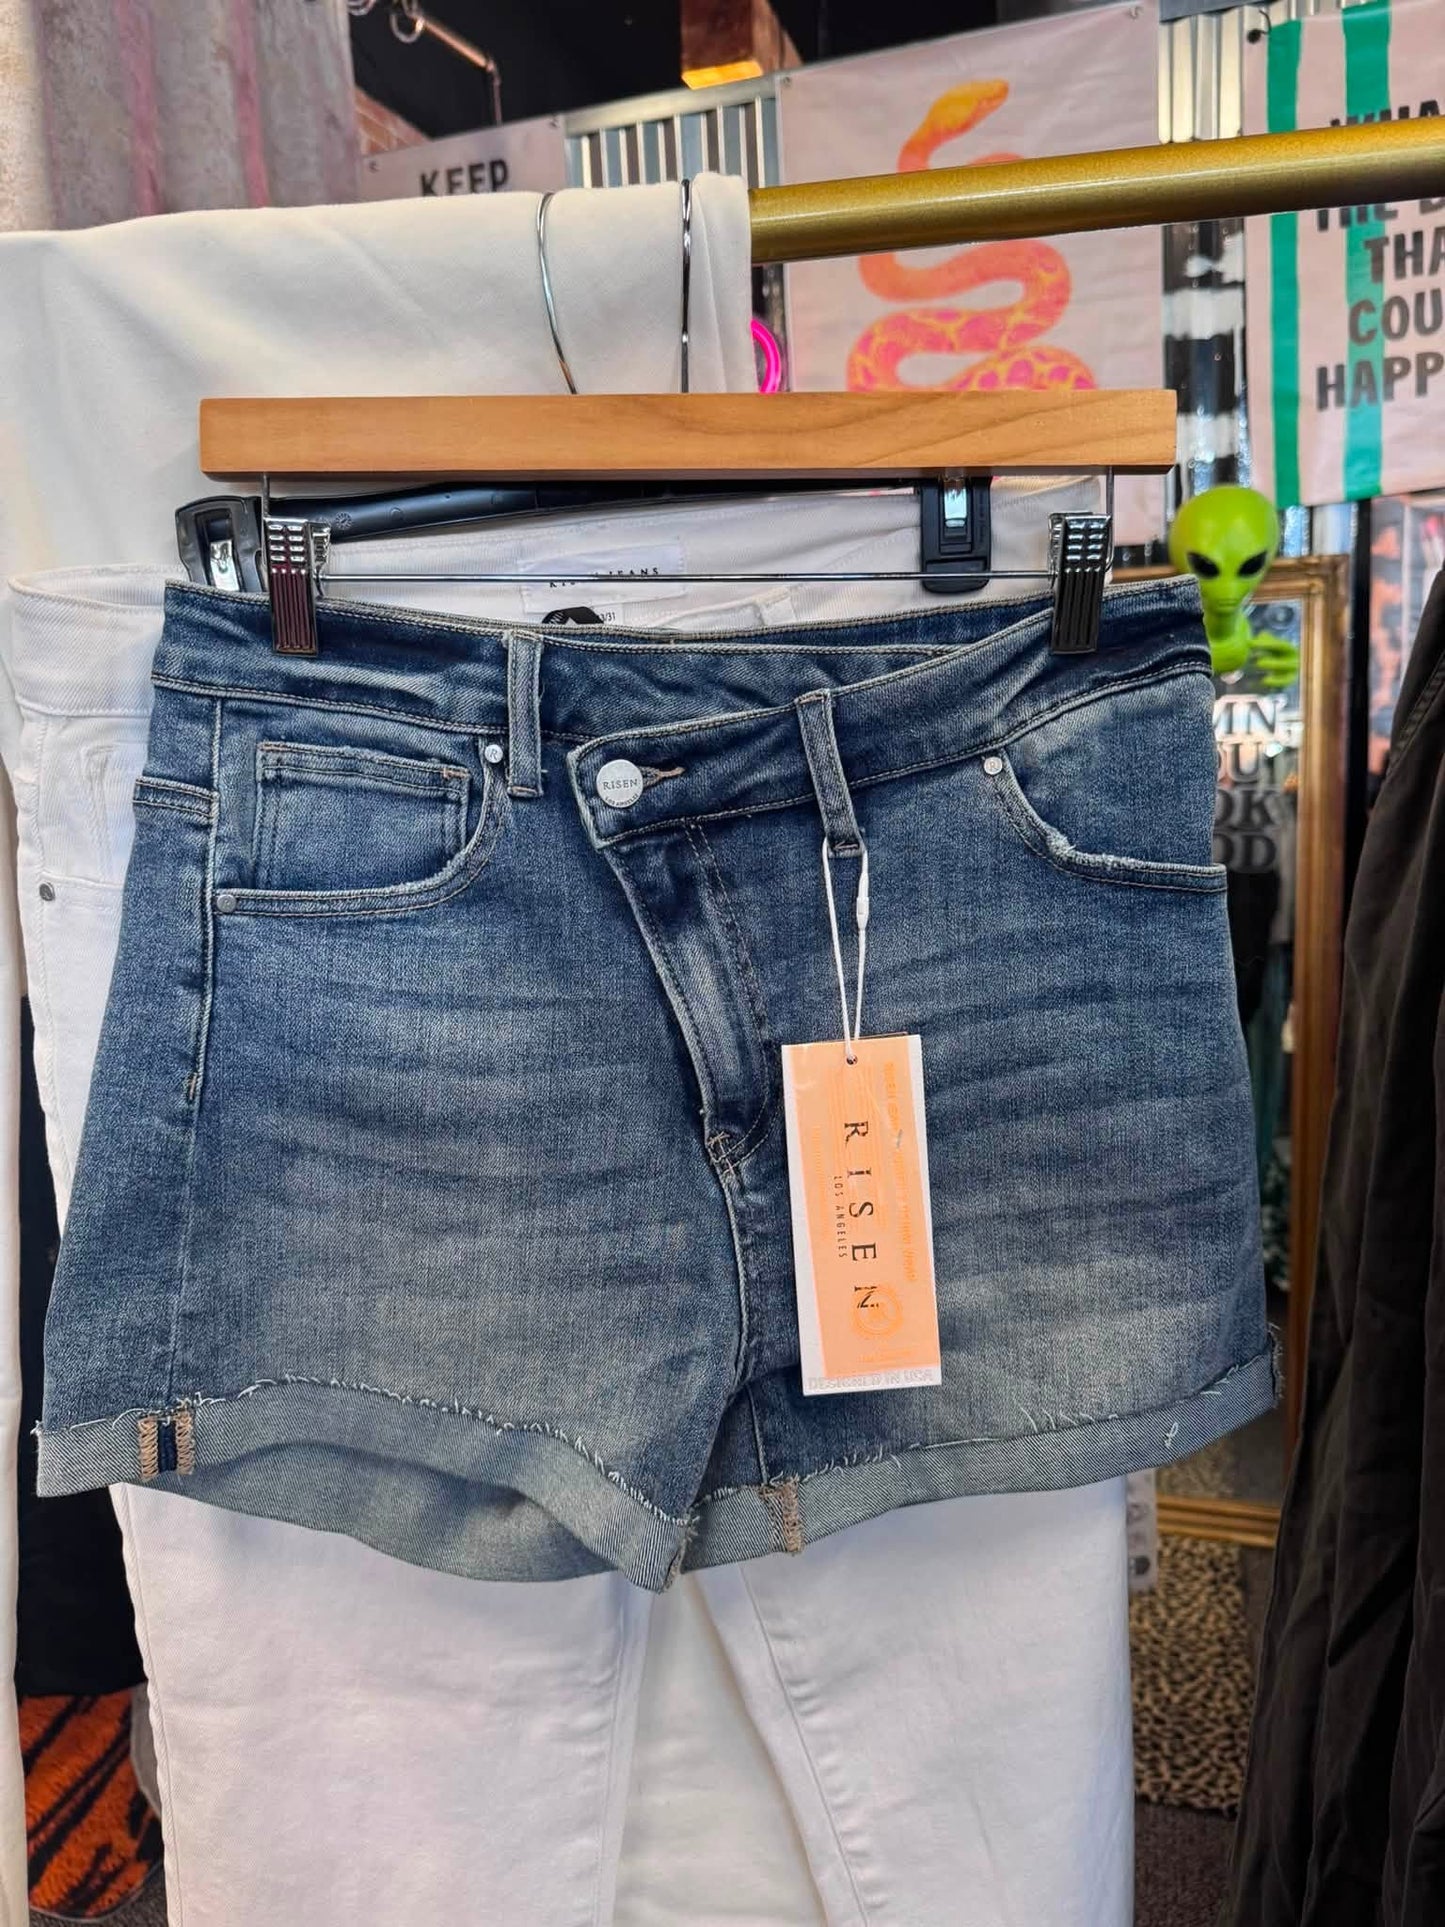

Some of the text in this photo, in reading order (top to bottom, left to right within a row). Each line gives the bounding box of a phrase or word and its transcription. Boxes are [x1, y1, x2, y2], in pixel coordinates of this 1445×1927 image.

[1349, 288, 1443, 346] COU
[1316, 352, 1444, 412] HAPP
[602, 779, 638, 790] RISEN
[833, 1175, 848, 1258] LOS ANGELES
[844, 1121, 879, 1309] RISEN
